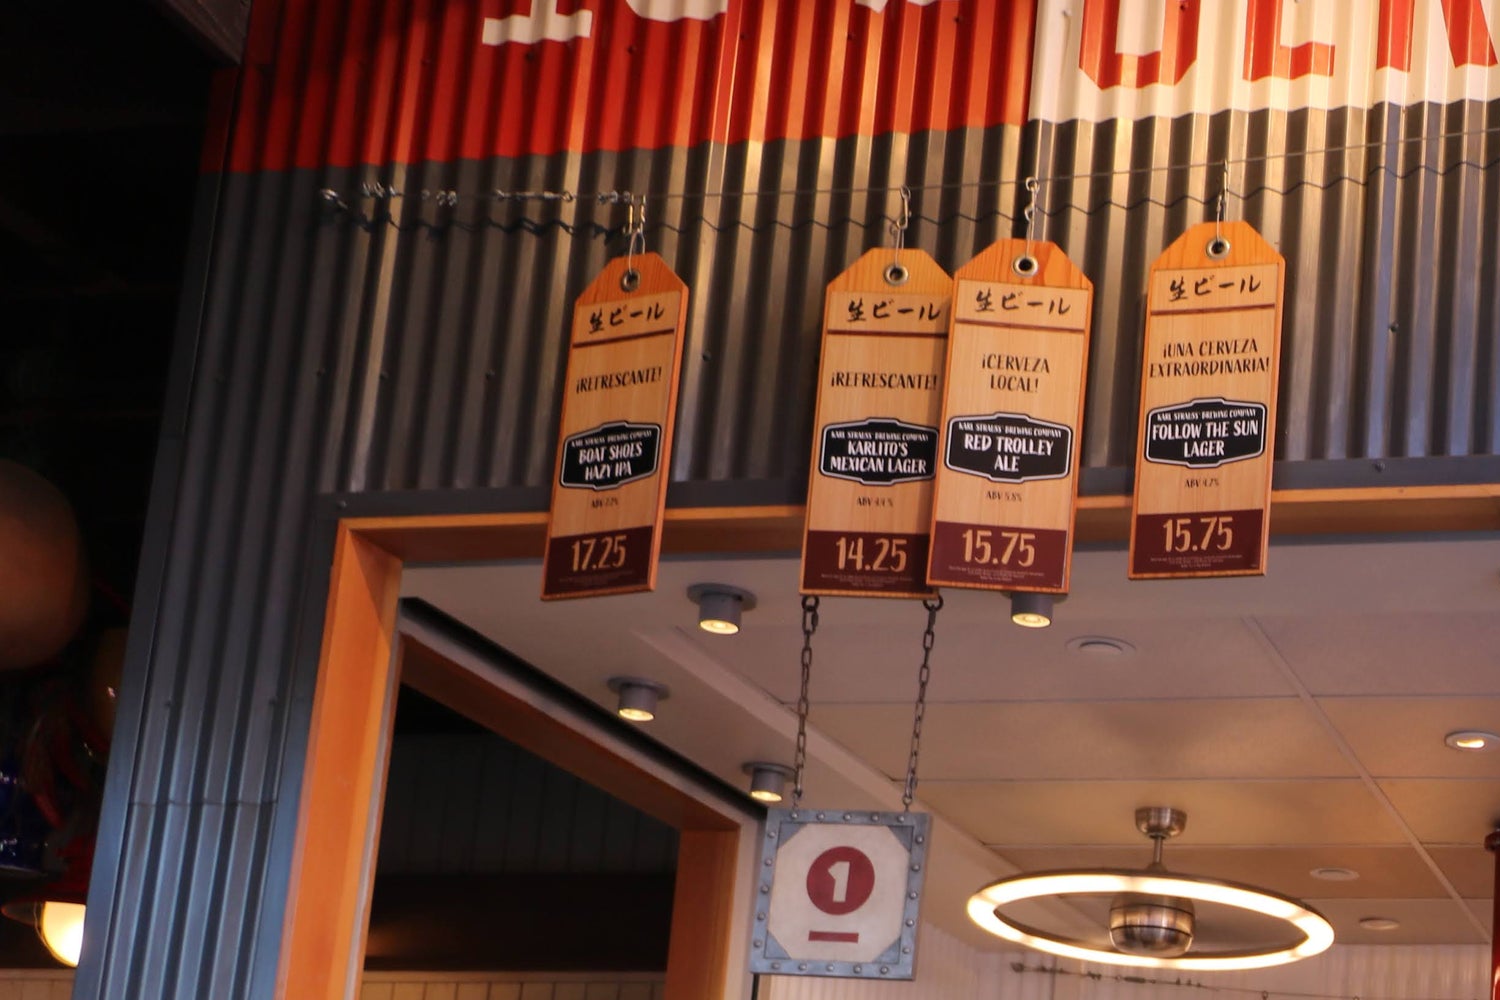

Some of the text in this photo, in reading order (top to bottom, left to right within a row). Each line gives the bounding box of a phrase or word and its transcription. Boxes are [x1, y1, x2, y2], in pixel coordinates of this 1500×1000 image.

[1168, 274, 1262, 302] 生ビール
[847, 298, 941, 323] 生ビール
[975, 288, 1072, 316] 生ビール
[588, 302, 665, 334] 生ビール
[1162, 338, 1259, 359] ¡UNA CERVEZA
[981, 353, 1051, 375] ¡CERVEZA
[1149, 356, 1270, 380] EXTRAORDINARIA!
[830, 371, 938, 391] ¡REFRESCANTE!
[989, 374, 1040, 393] LOCAL!
[1157, 411, 1172, 421] KARL
[1201, 409, 1228, 420] BREWING
[1229, 408, 1257, 418] COMPANY
[958, 421, 974, 432] KARL
[1005, 425, 1033, 436] BREWING
[1033, 427, 1062, 438] COMPANY
[1152, 419, 1259, 441] FOLLOW THE SUN
[579, 442, 643, 465] BOAT SHOES
[847, 440, 909, 457] KARLITO'S
[964, 433, 1054, 457] RED TROLLEY
[1184, 440, 1225, 458] LAGER
[585, 461, 632, 481] HAZY IPA
[830, 455, 927, 475] MEXICAN LAGER
[994, 454, 1020, 473] ALE
[1184, 479, 1200, 488] ABV
[985, 490, 1001, 501] ABV
[1163, 516, 1233, 553] 15.75
[571, 535, 627, 572] 17.25
[835, 536, 908, 573] 14.25
[962, 528, 1036, 568] 15.75
[828, 861, 850, 902] 1
